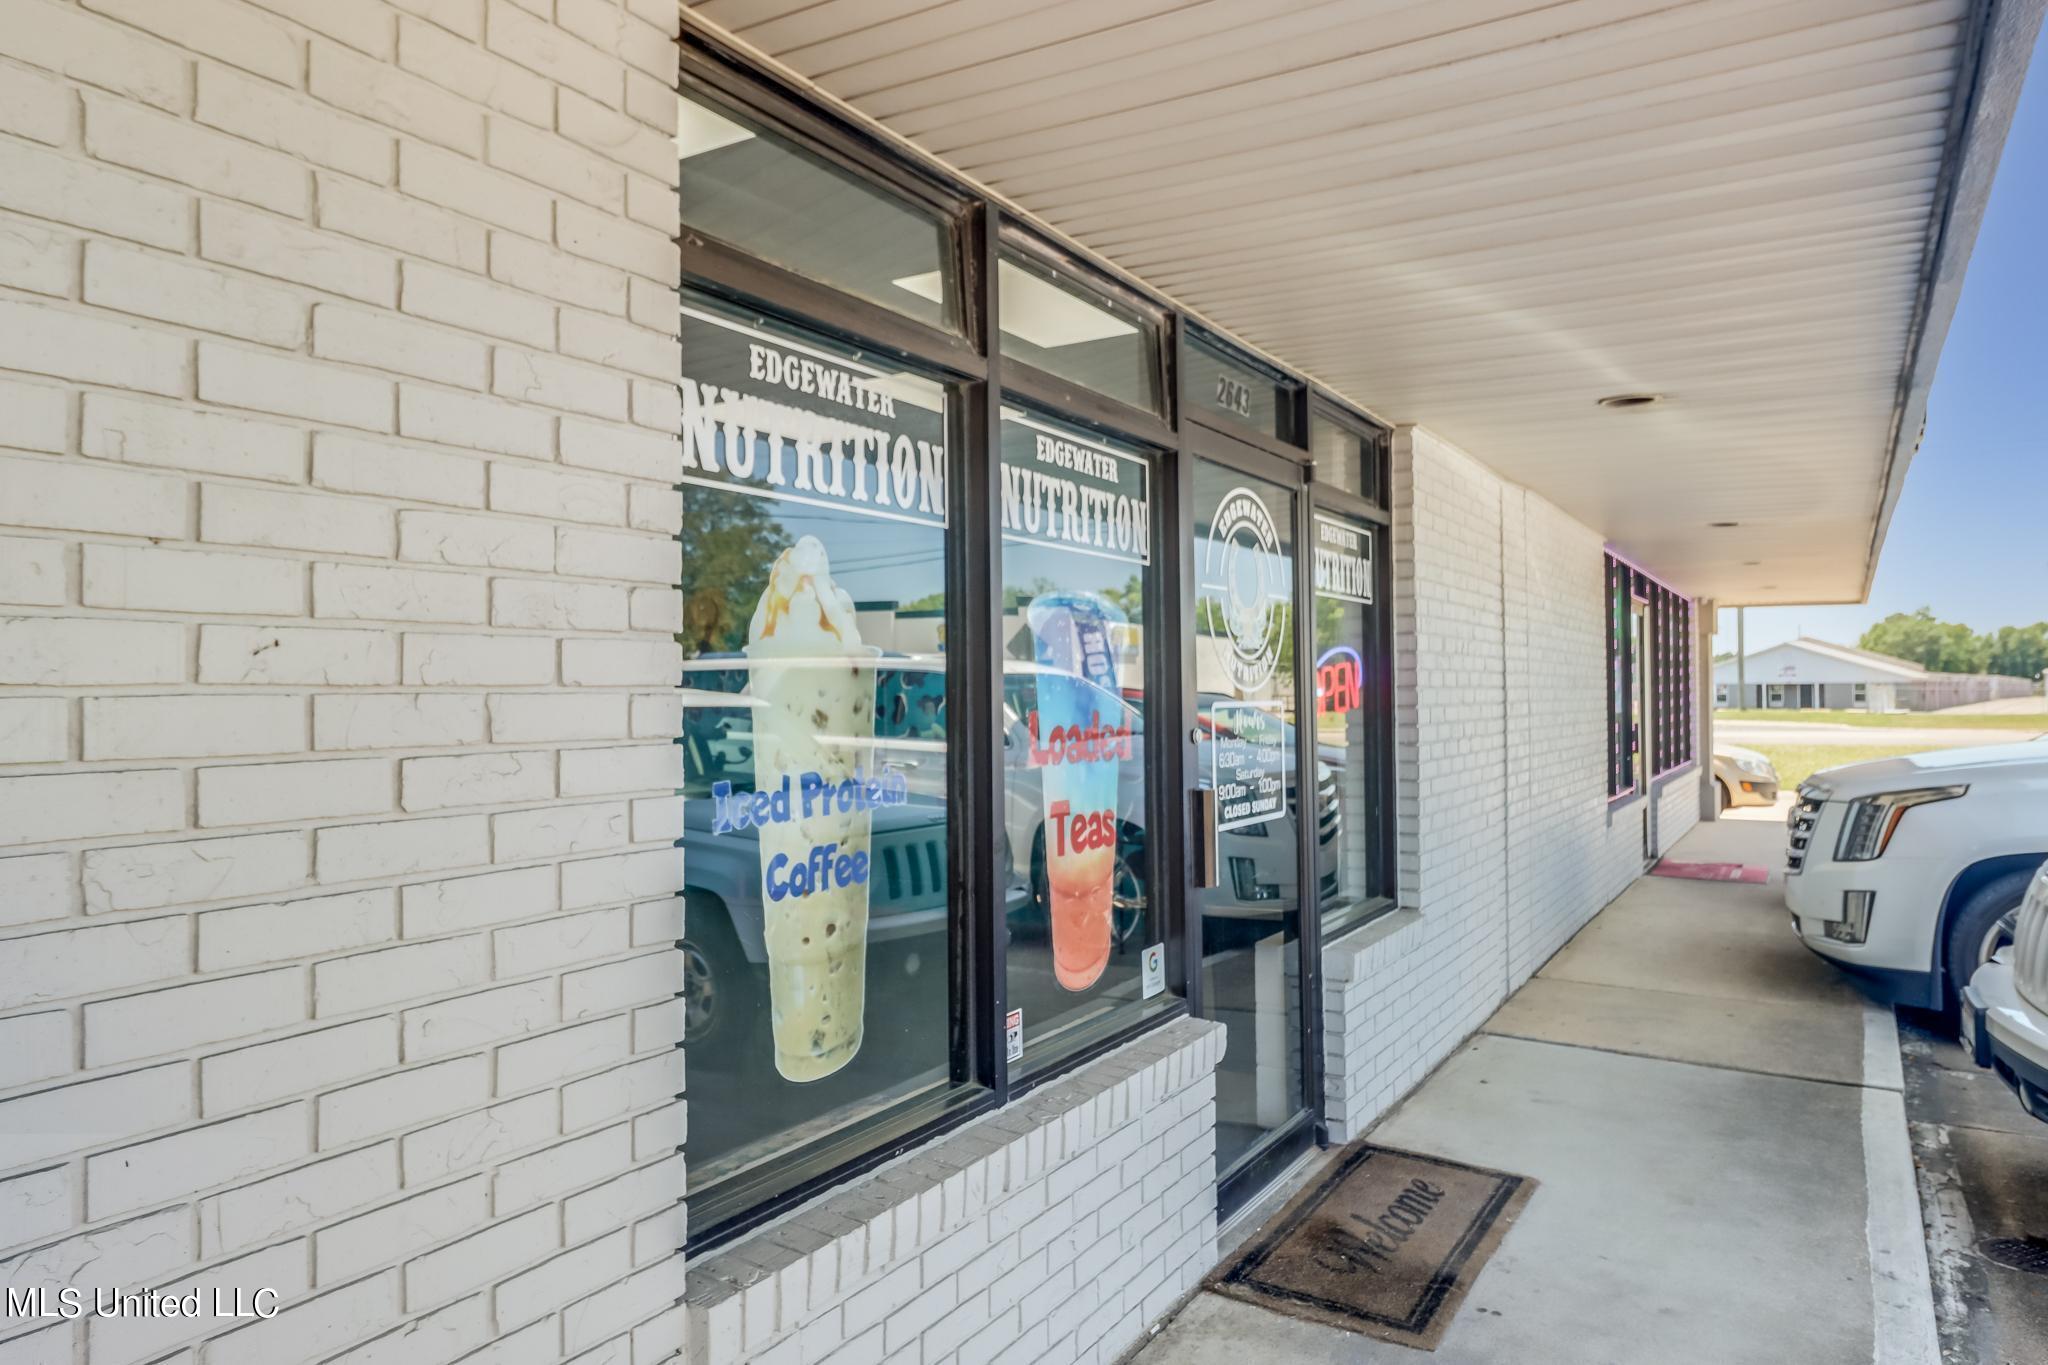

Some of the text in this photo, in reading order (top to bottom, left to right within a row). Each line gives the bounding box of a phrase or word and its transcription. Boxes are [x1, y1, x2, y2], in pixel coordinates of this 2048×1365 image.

[748, 343, 896, 419] EDGEWATER
[1216, 375, 1250, 416] 2643
[681, 376, 943, 516] NUTRITION
[1035, 434, 1119, 484] EDGEWATER
[1001, 462, 1147, 555] NUTRITION
[1218, 499, 1274, 550] EDGEWATER
[1320, 523, 1358, 551] EDGEWATER
[1314, 547, 1372, 598] UTRITION
[1026, 709, 1133, 768] Loaded
[711, 765, 907, 835] Iced Protein
[1235, 768, 1265, 781] Saturday
[1050, 799, 1116, 857] Teas
[1224, 797, 1278, 819] CLOSED SUNDAY
[766, 842, 869, 902] Coffee
[1148, 951, 1159, 973] G
[1313, 1178, 1446, 1275] Welcome
